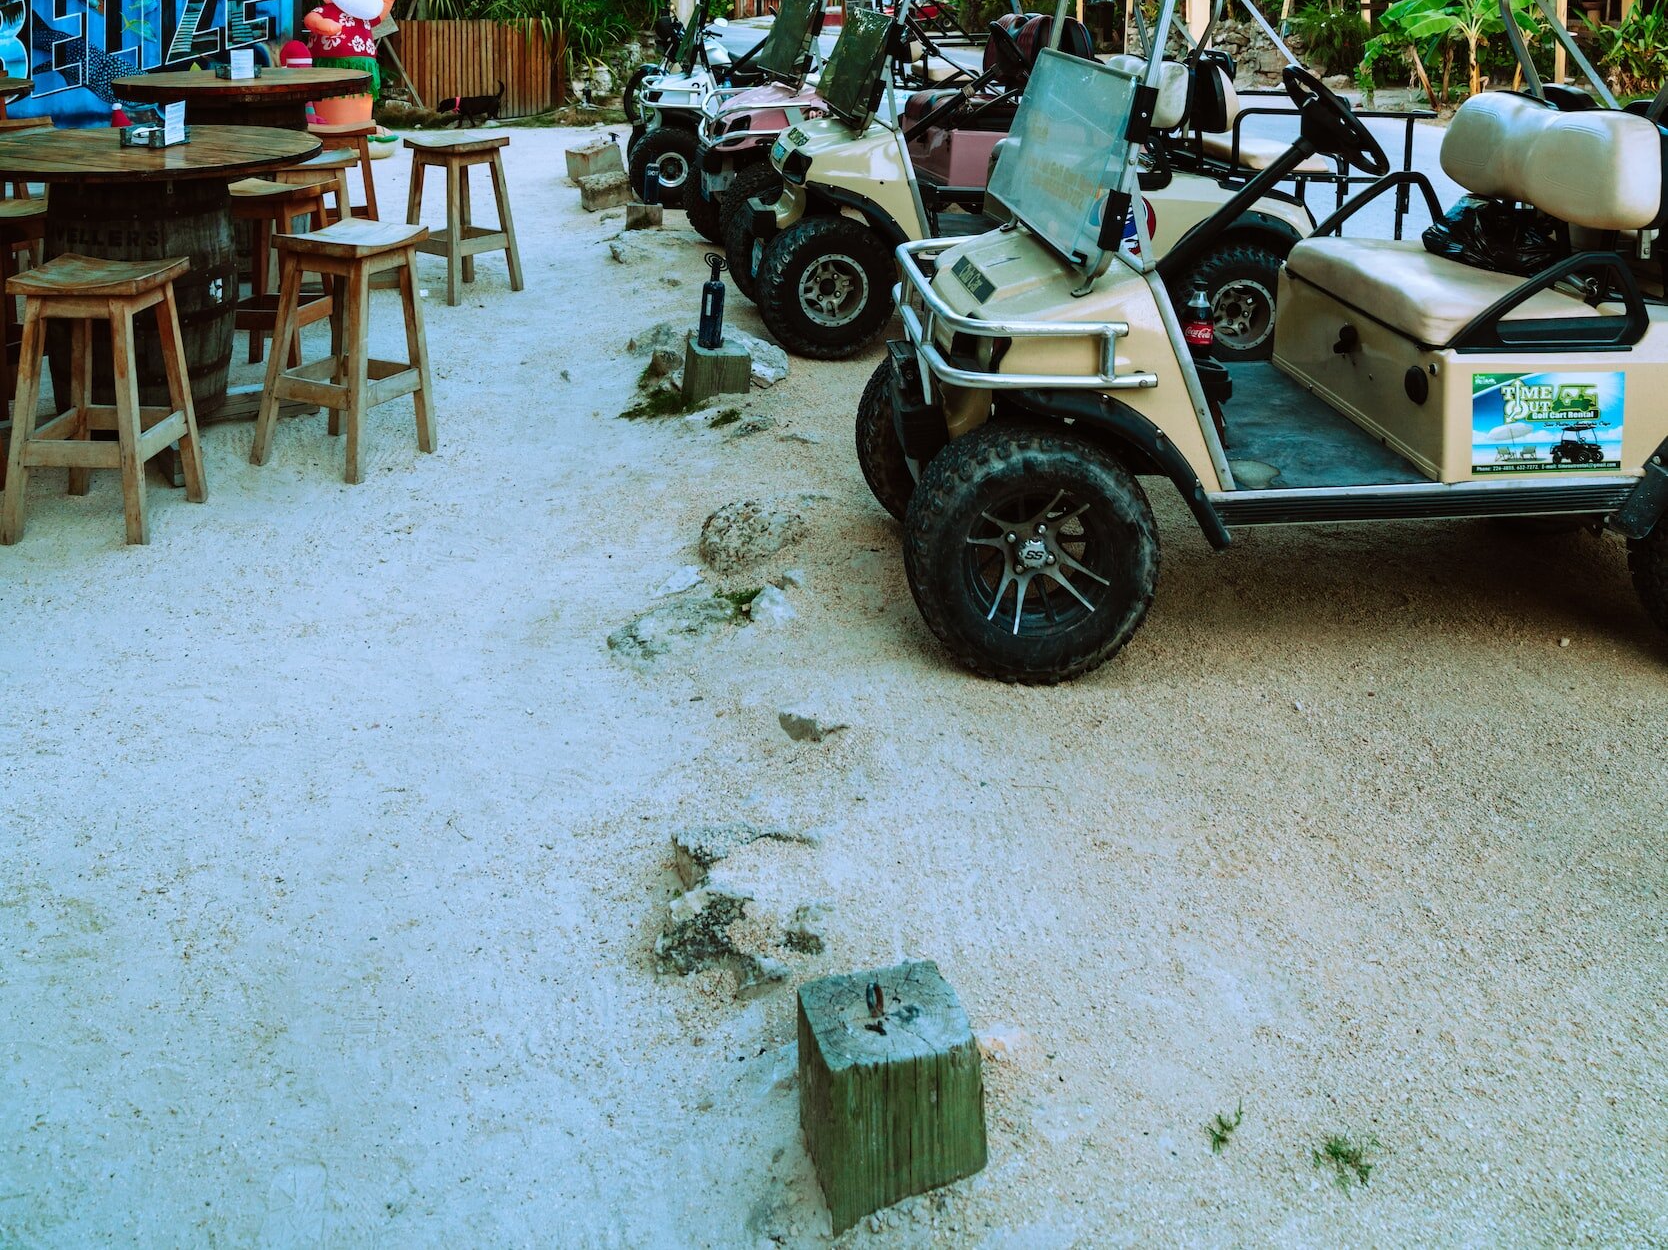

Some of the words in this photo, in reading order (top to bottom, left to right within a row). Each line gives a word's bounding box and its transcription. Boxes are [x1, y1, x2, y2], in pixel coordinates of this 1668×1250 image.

[1502, 380, 1553, 400] TIME
[1505, 401, 1551, 421] OUT
[1532, 411, 1548, 419] Golf
[1549, 410, 1567, 419] Cart
[1567, 410, 1594, 419] Rental
[1025, 550, 1044, 560] SS
